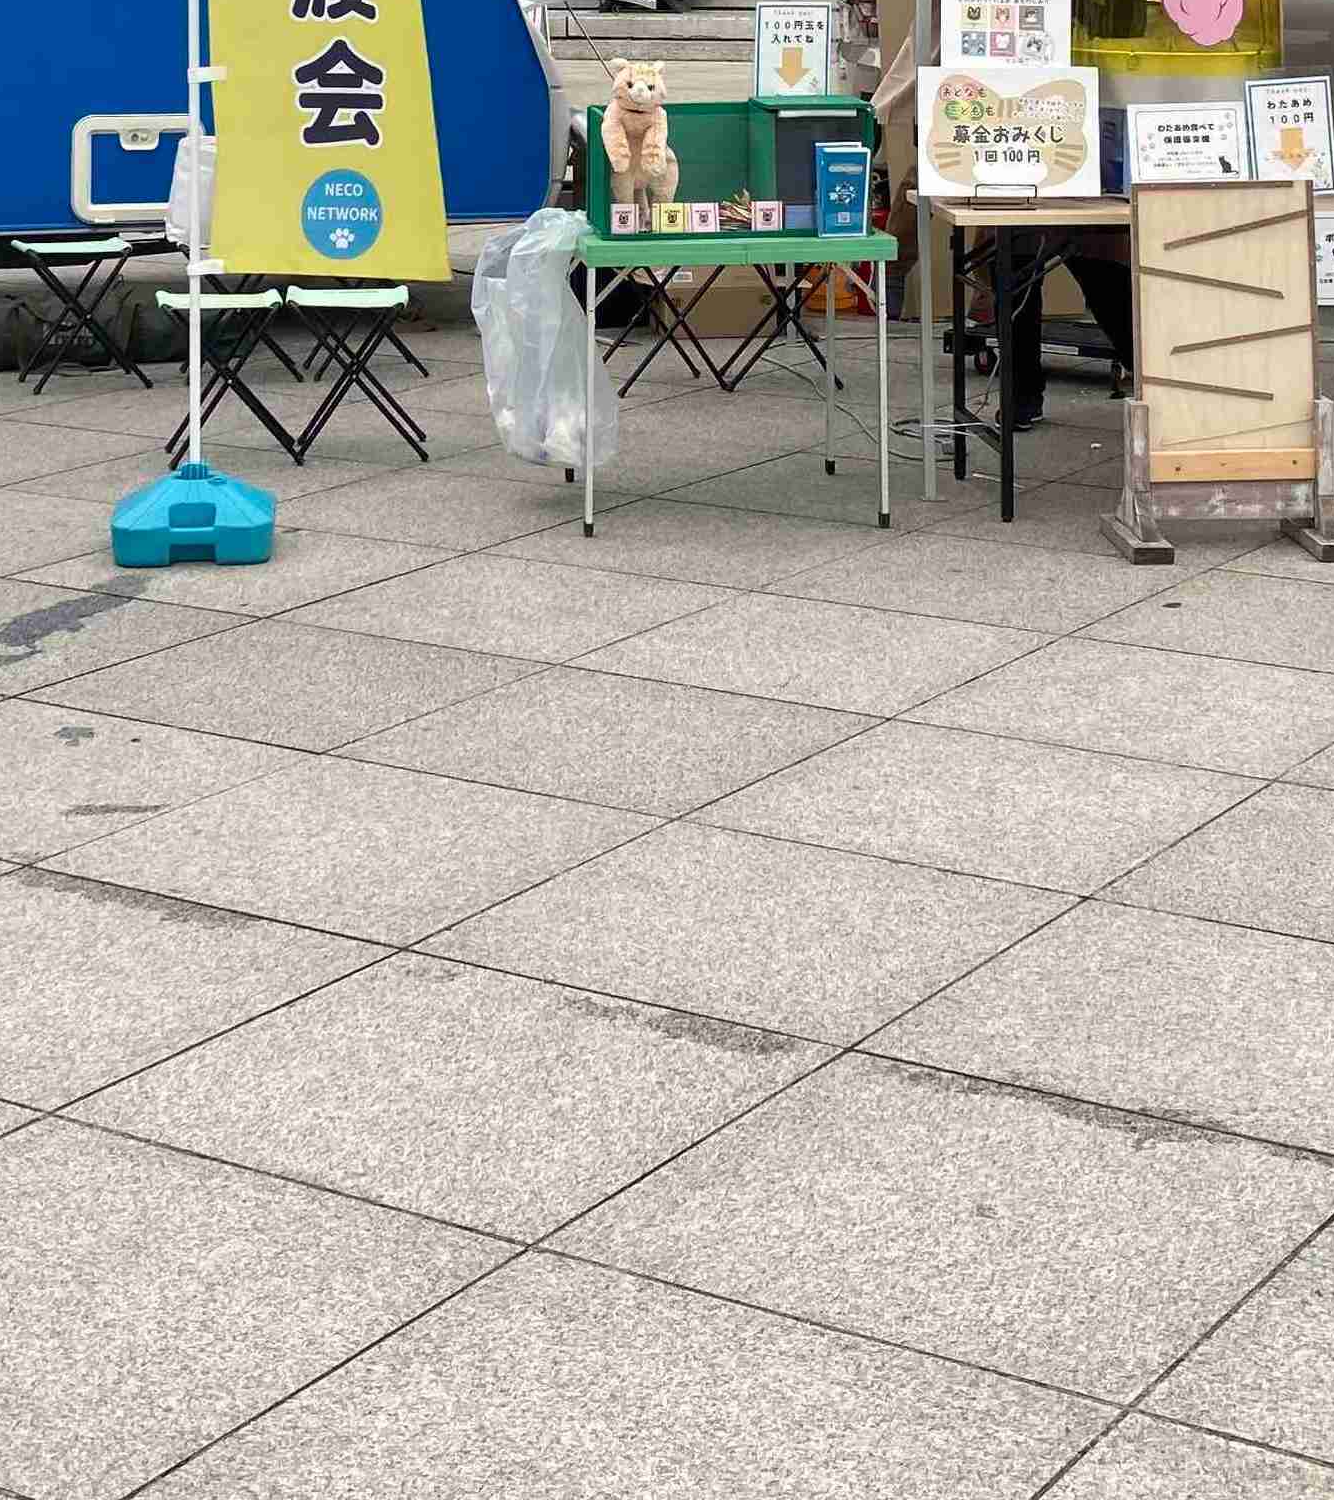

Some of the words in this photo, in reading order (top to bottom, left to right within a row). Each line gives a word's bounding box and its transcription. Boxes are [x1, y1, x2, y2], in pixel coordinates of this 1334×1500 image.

[765, 20, 825, 30] 100円玉を
[770, 34, 814, 44] 入れてね
[1267, 98, 1312, 109] わたあめ
[1269, 112, 1314, 124] 100円
[953, 124, 1063, 143] 募金おみくじ
[974, 150, 1040, 163] 1回100円
[324, 182, 364, 198] NECO
[307, 206, 379, 222] NETWORK
